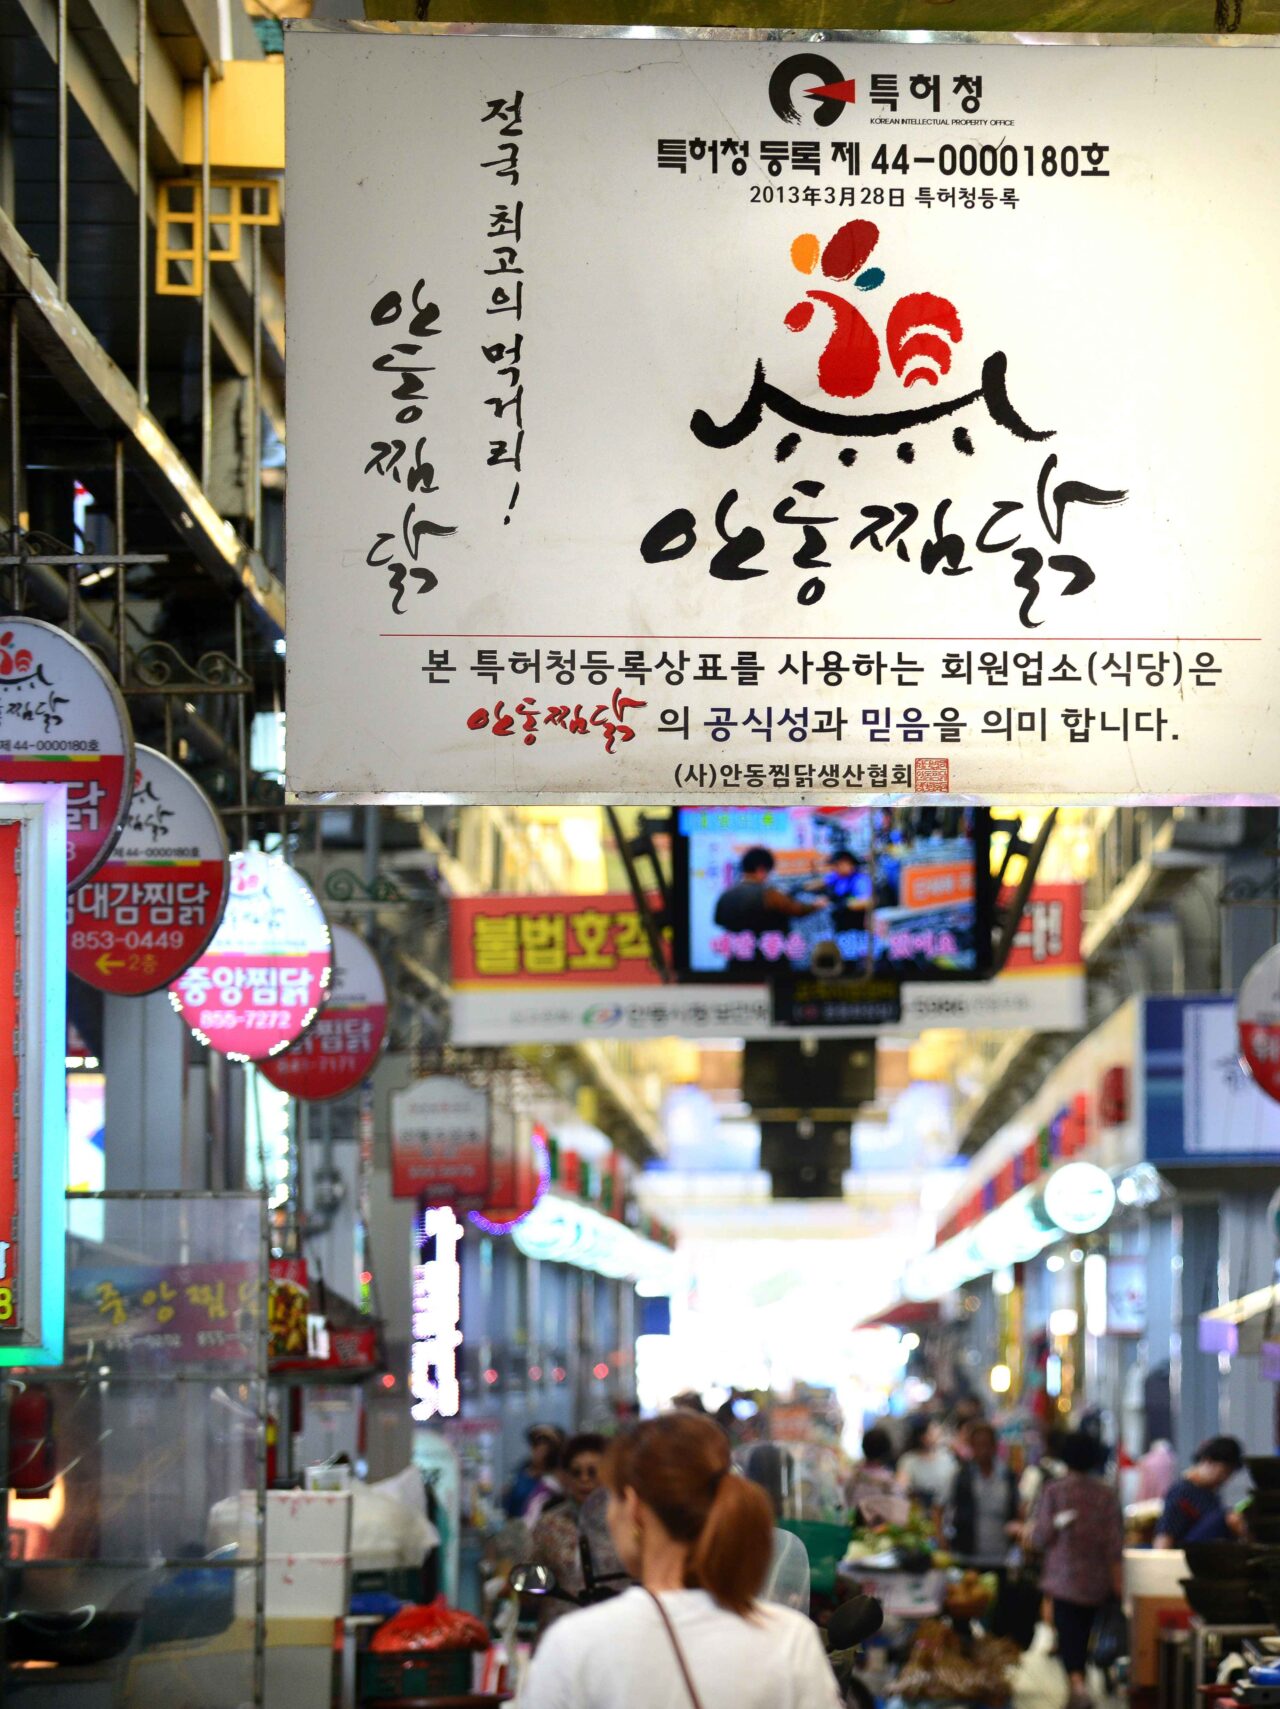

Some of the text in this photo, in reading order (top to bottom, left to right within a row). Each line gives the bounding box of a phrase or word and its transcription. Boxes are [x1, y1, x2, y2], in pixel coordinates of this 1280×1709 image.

[869, 74, 983, 114] 특허청
[480, 90, 524, 186] 전국
[901, 118, 949, 126] INTELLECTUAL
[657, 138, 1110, 177] 특허청 등록 제 44-0000180호
[914, 187, 1020, 210] 특허청등록
[484, 201, 524, 321] 최고의
[364, 278, 459, 616] 안동찜닭
[639, 453, 1130, 629] 안동찜닭
[421, 649, 1223, 688] 본 특허청등록상표를 사용하는 회원업소(식당)은
[0, 690, 71, 734] 찜닭
[467, 687, 1180, 755] 안동찜닭 의 공식성과 믿음을 의미 합니다.
[13, 739, 101, 752] 44-0000180호
[674, 762, 913, 789] (사)안동찜닭생산협회
[71, 930, 185, 949] 853-0449
[178, 966, 315, 1007] 중앙찜닭
